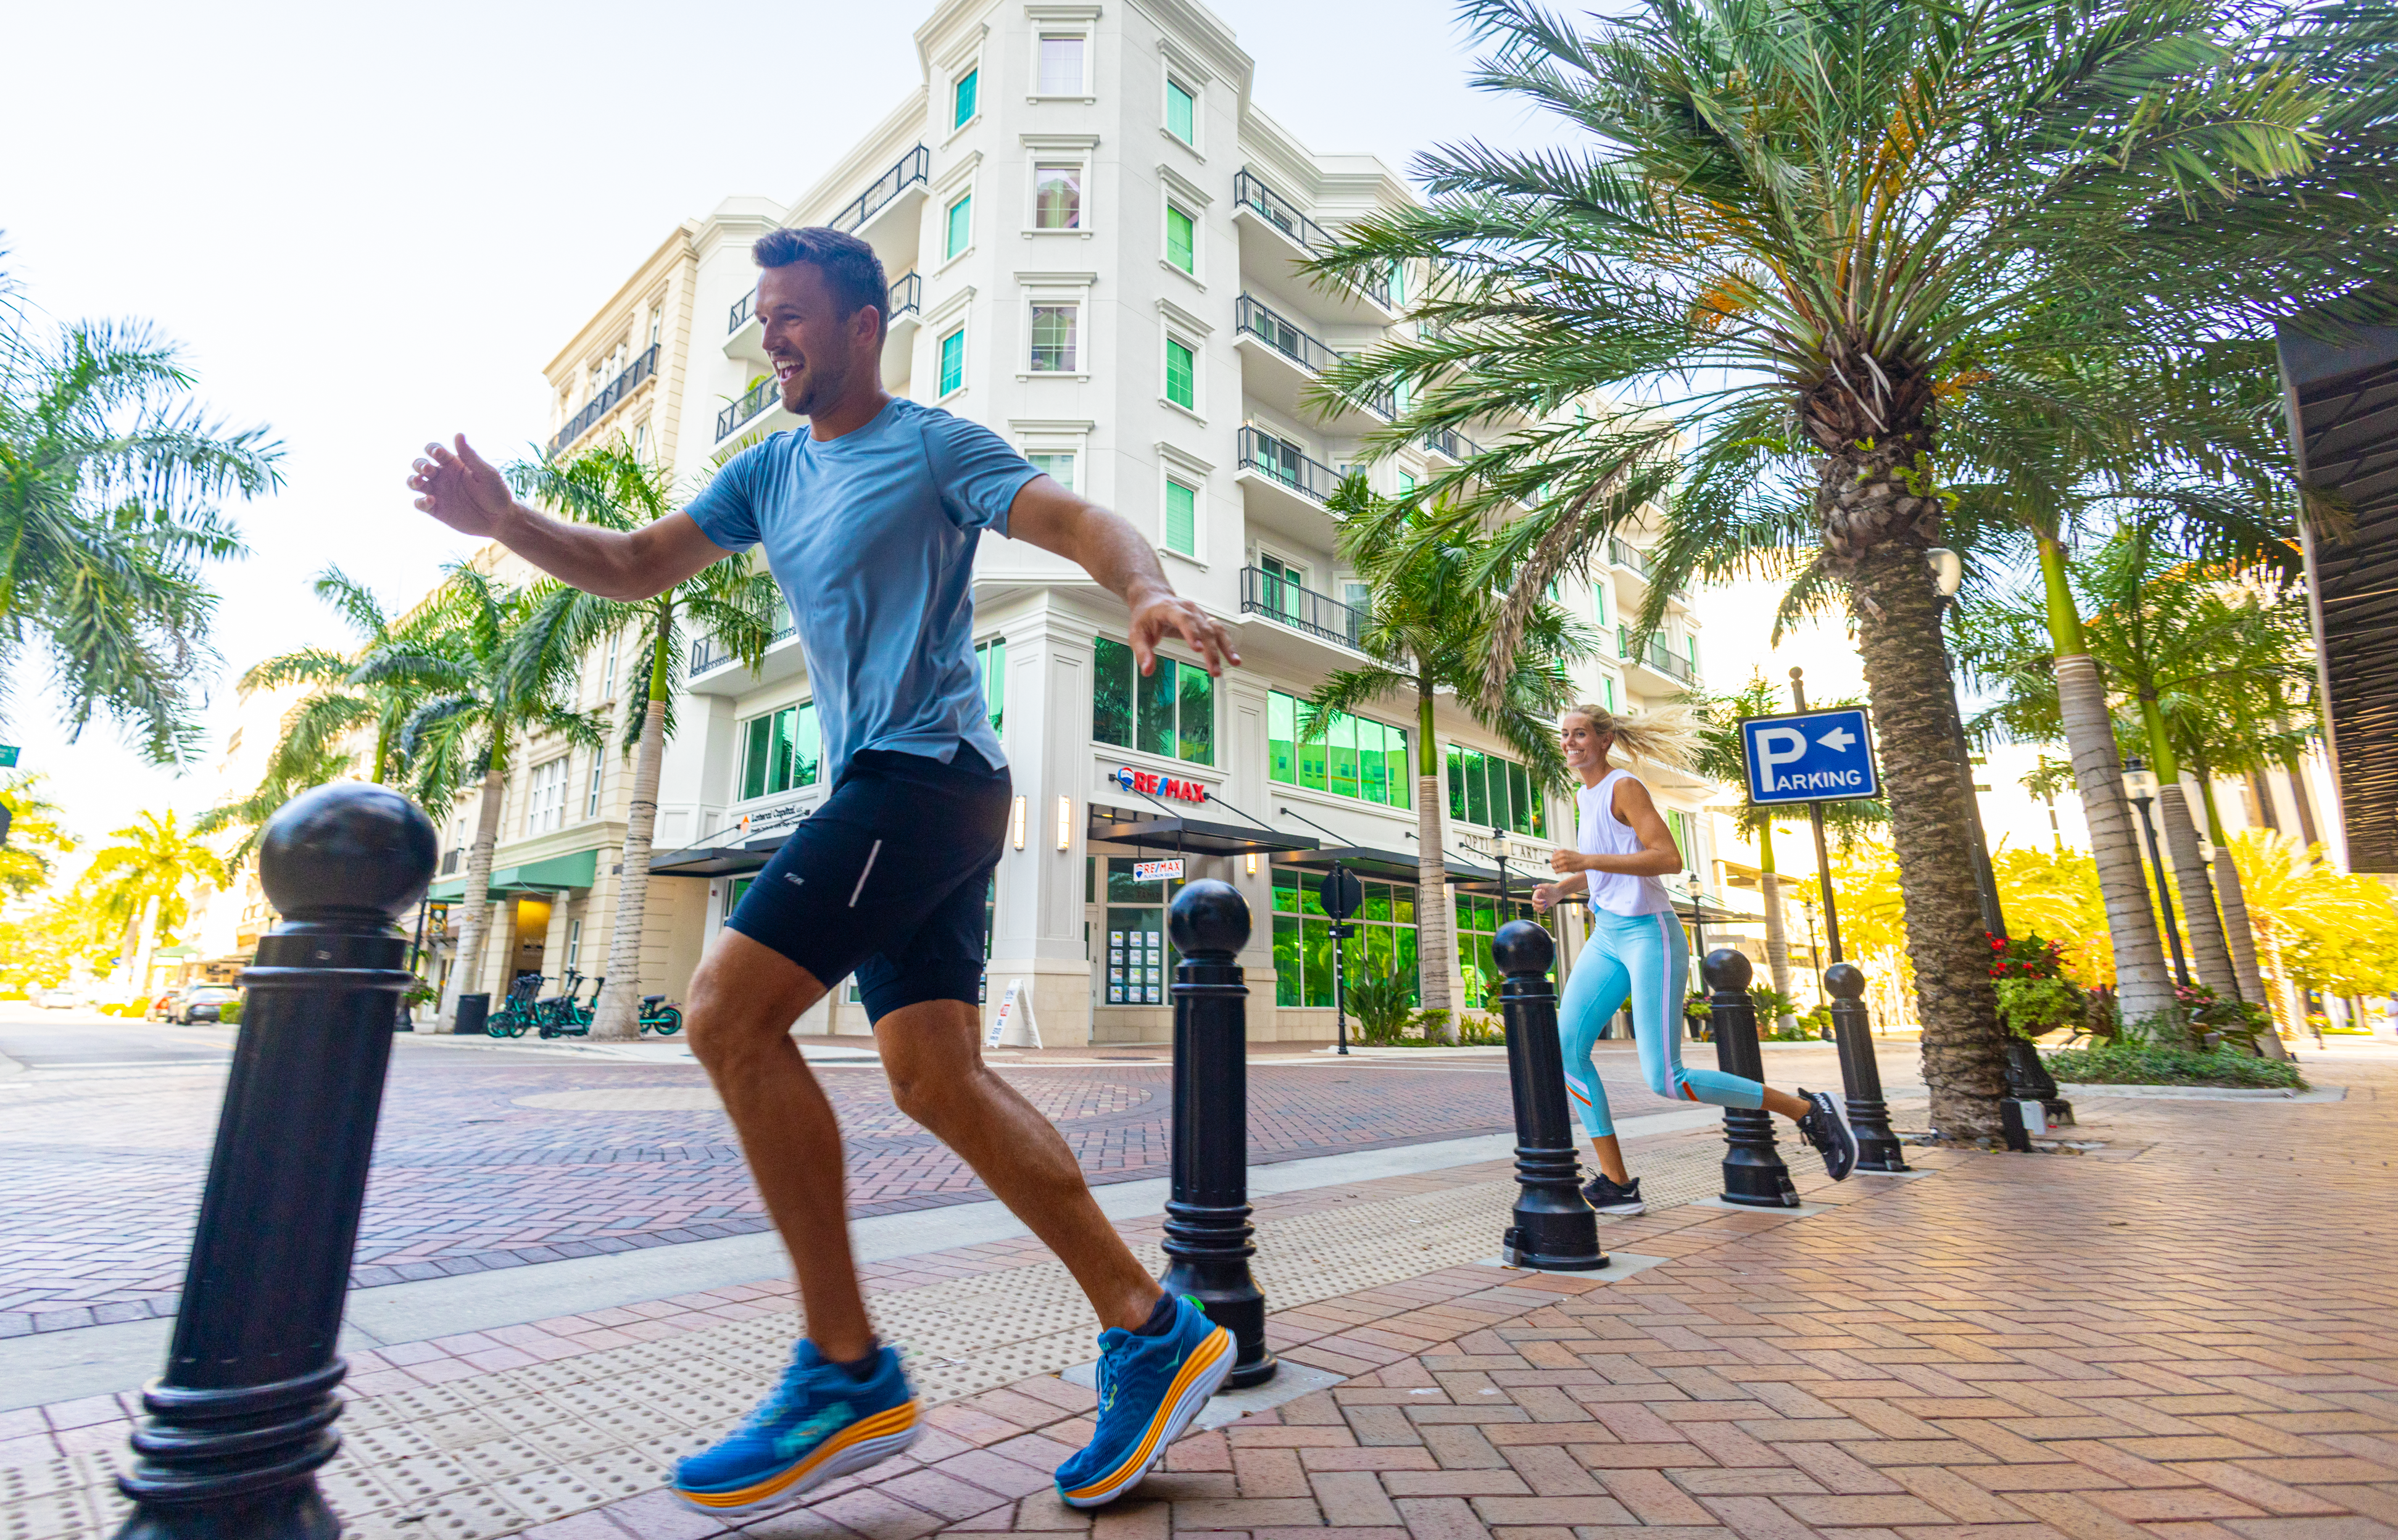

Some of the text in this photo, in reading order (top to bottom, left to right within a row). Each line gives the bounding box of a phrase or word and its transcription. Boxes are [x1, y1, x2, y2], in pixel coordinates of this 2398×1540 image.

[1754, 727, 1862, 792] PARKING
[1134, 771, 1206, 803] RE/MAX
[1465, 834, 1516, 856] OPTIL
[1144, 861, 1180, 874] RE/MAX
